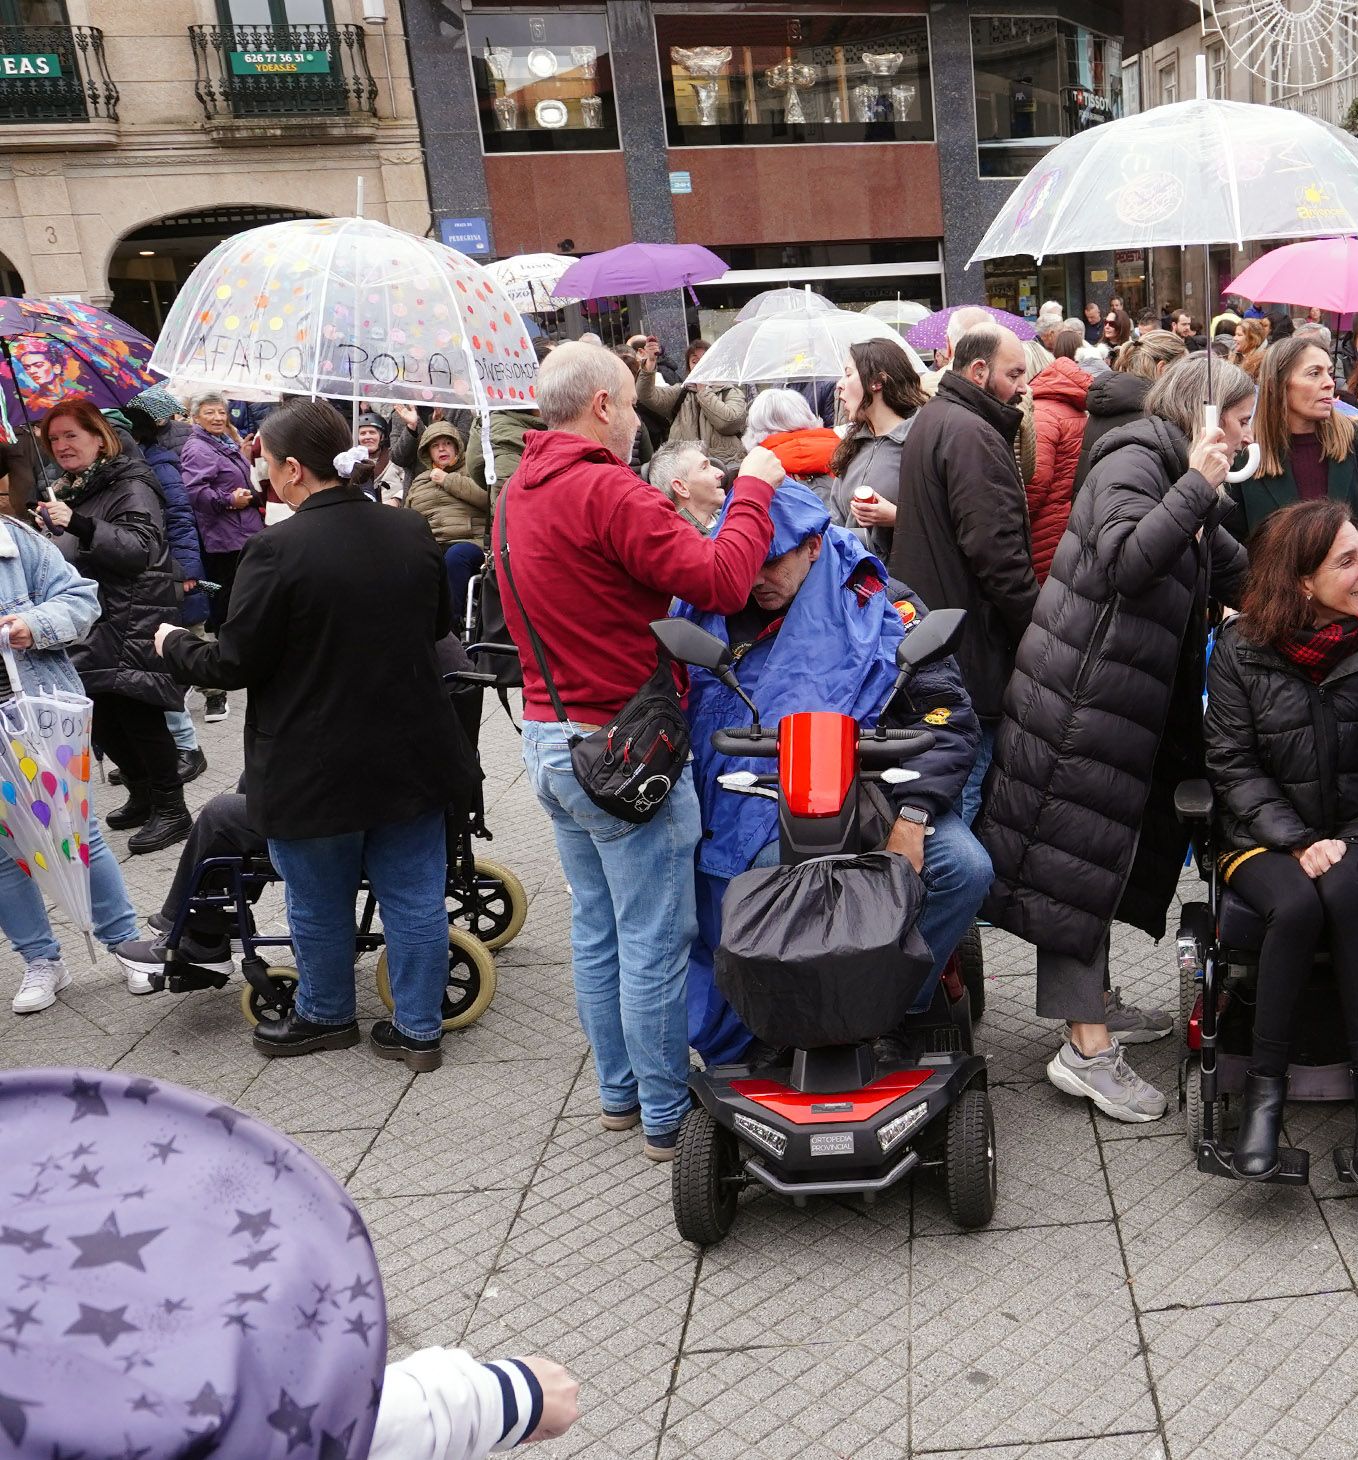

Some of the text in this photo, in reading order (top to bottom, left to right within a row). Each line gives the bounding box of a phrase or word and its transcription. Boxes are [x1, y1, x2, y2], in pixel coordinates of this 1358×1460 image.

[244, 54, 305, 63] 626 77 36 31
[0, 57, 50, 75] EAS
[255, 63, 297, 72] YDEAS.ES
[1083, 91, 1110, 111] TISSOT
[45, 226, 58, 244] 3
[186, 335, 304, 379] AFAPO
[811, 1135, 853, 1144] ORTOPEDIA
[811, 1143, 853, 1152] PROVINCIAL
